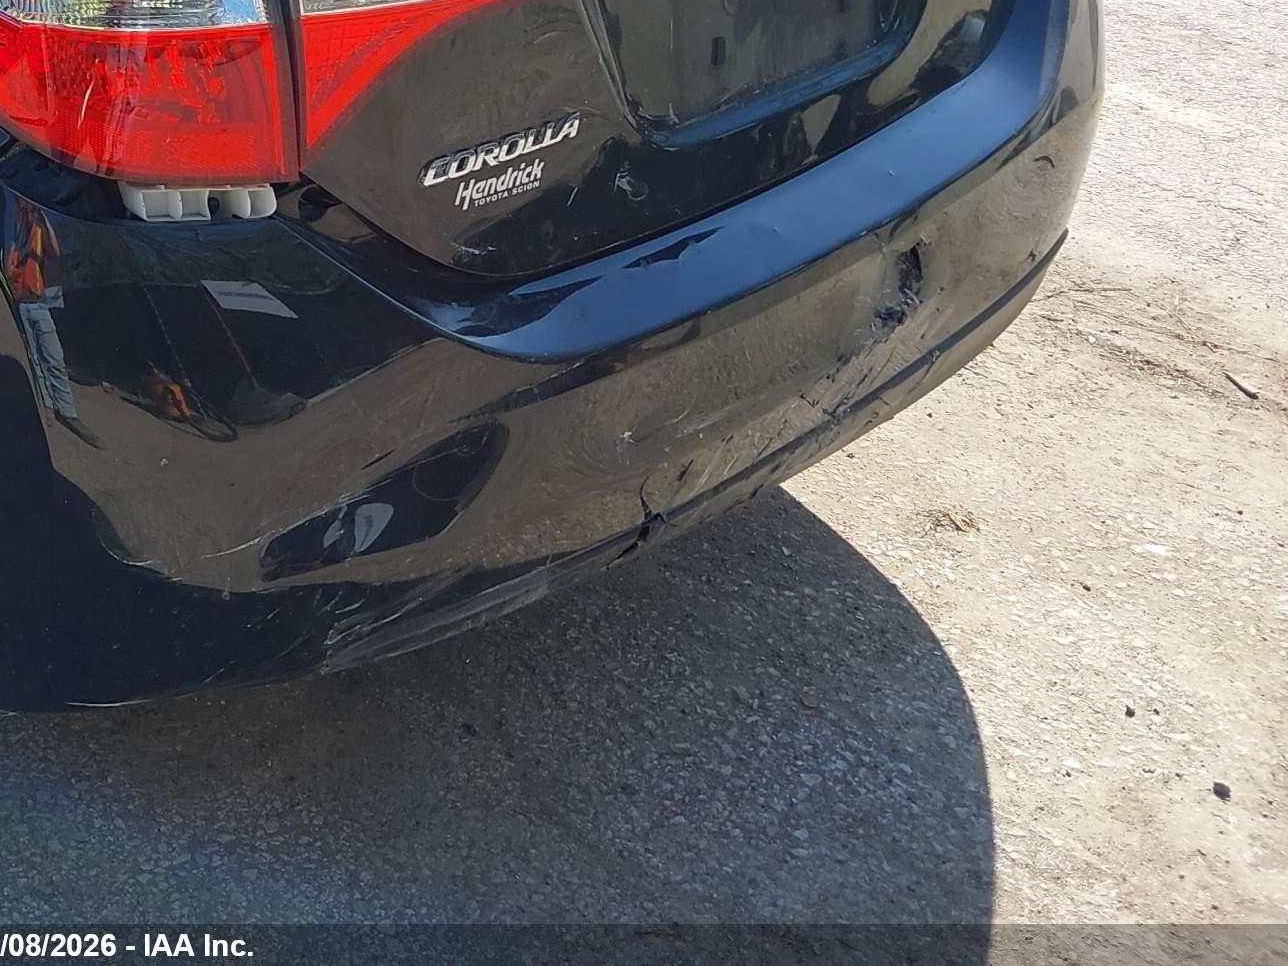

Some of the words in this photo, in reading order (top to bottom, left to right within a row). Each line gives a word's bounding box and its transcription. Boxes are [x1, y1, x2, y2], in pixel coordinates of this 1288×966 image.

[420, 111, 580, 186] COROLLA
[454, 158, 545, 210] Hendrick
[474, 190, 509, 207] TOYOTA
[511, 180, 540, 195] SCION
